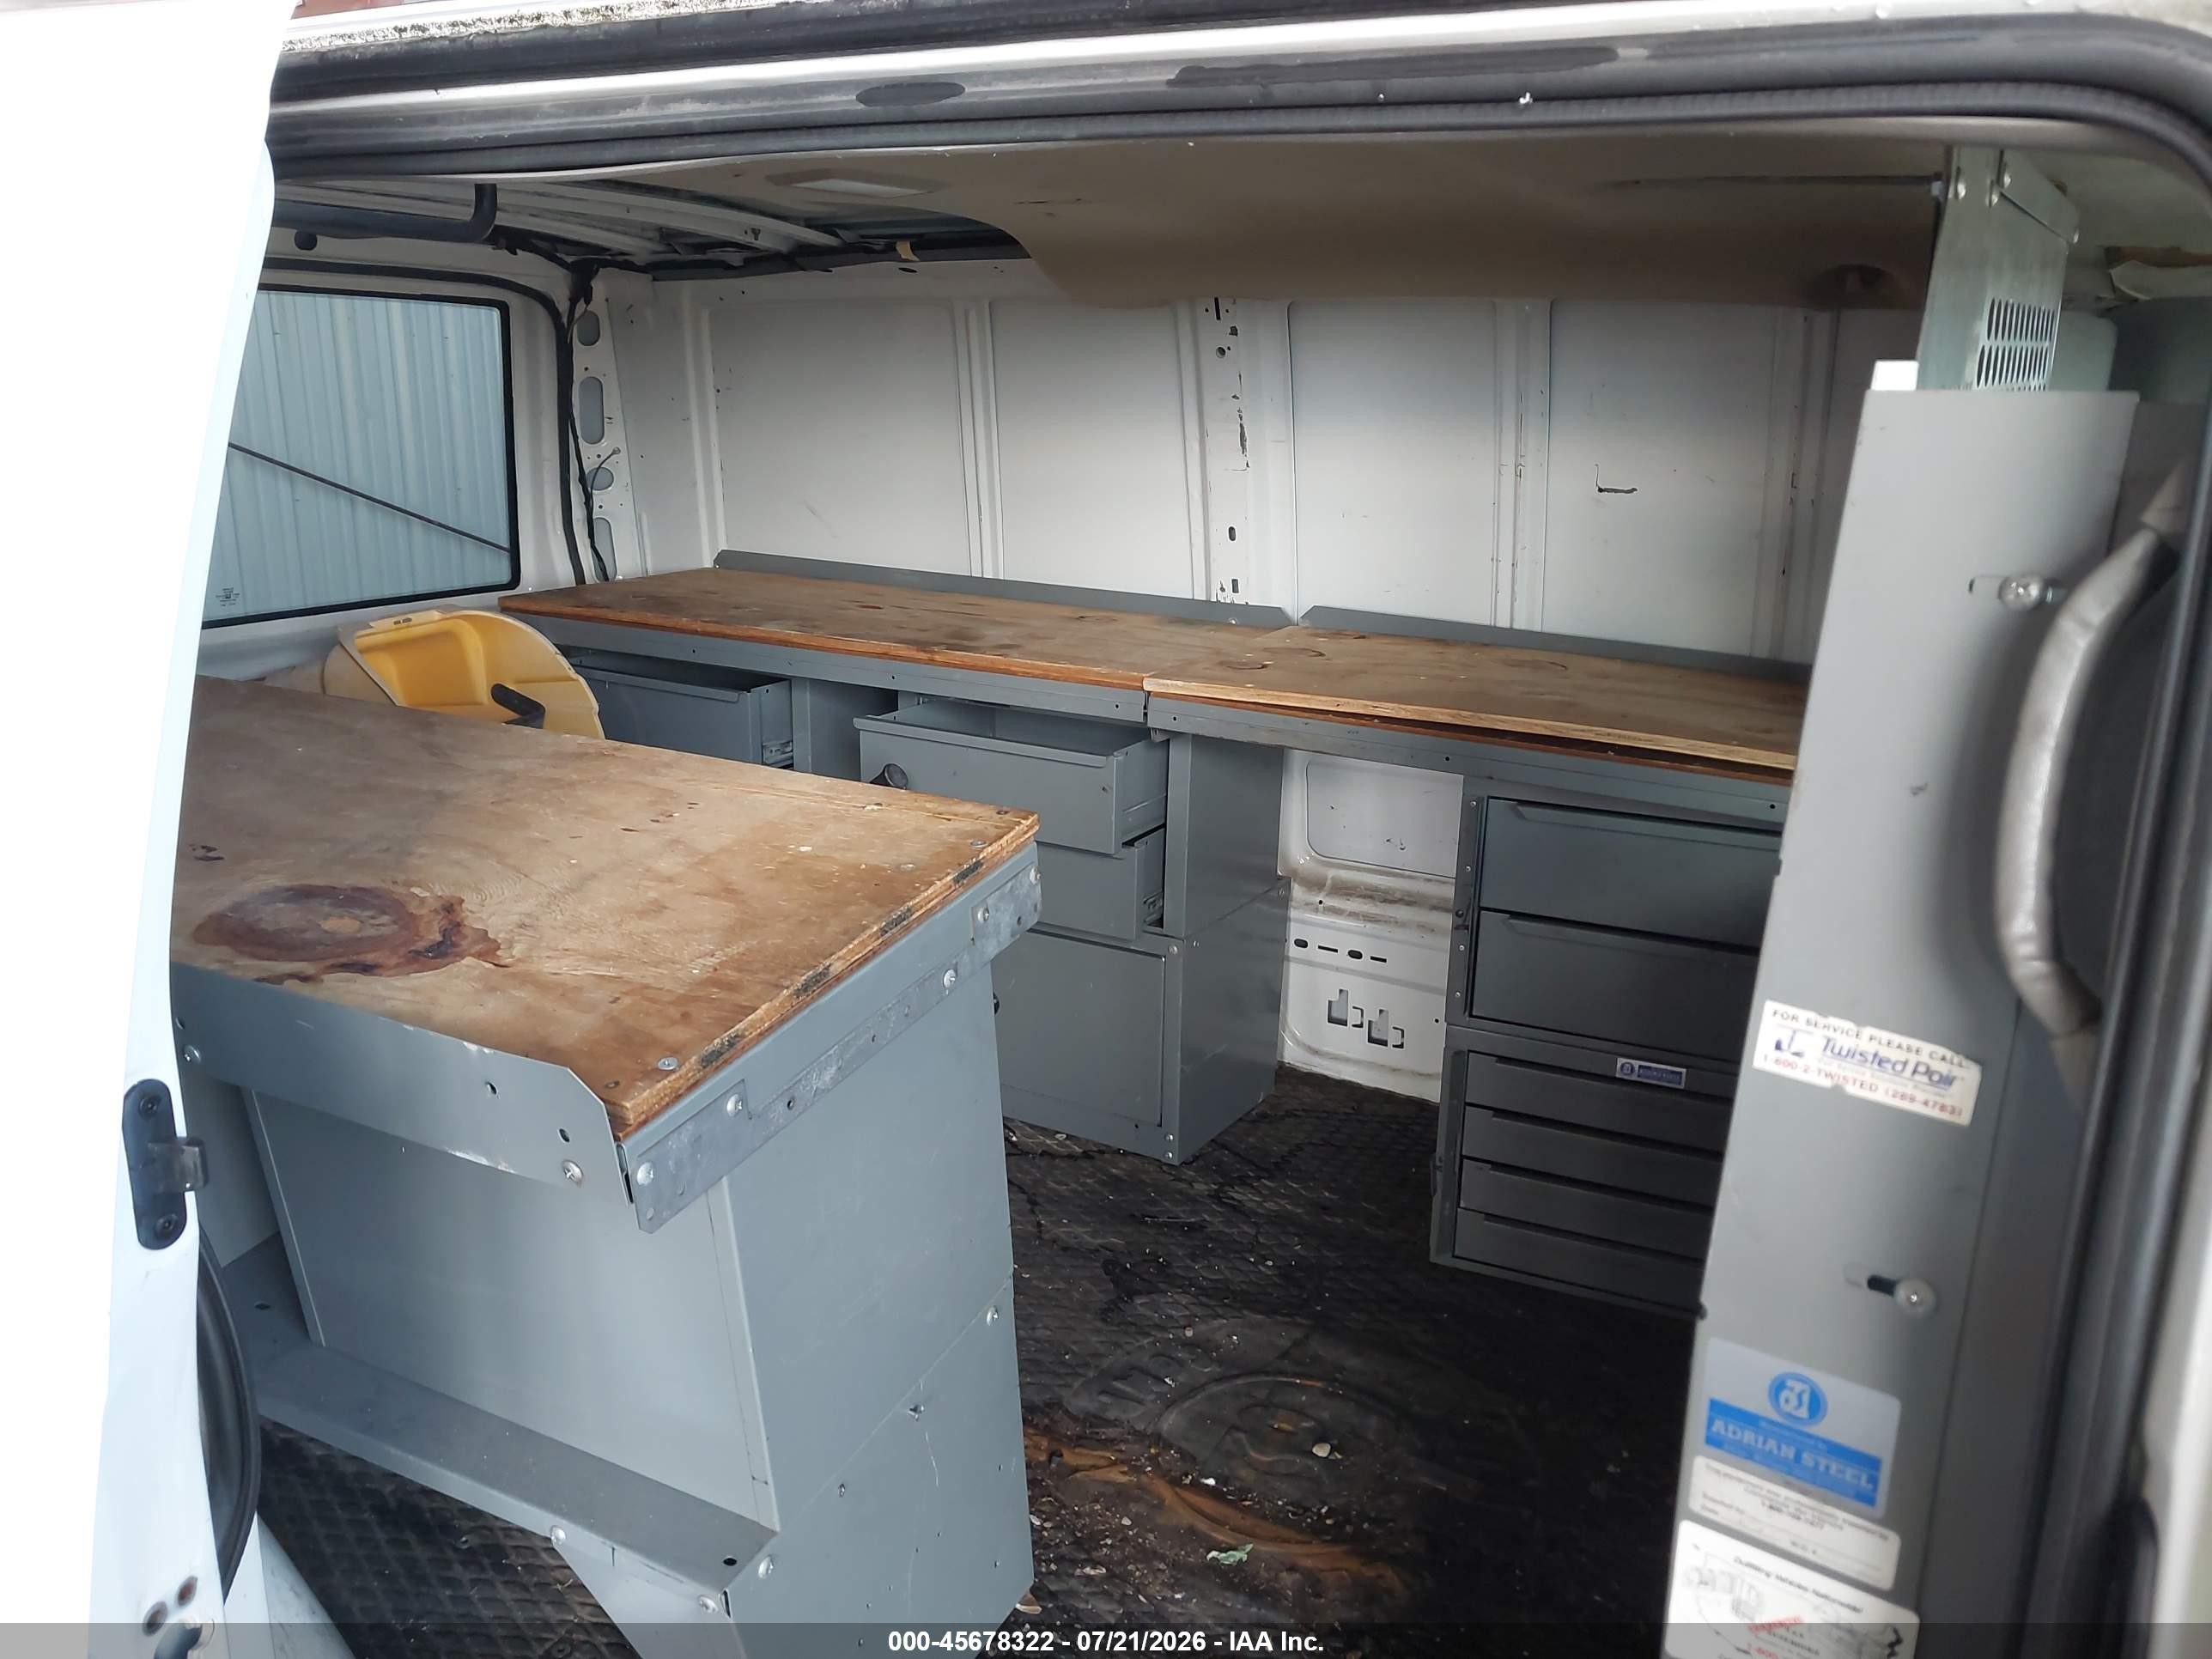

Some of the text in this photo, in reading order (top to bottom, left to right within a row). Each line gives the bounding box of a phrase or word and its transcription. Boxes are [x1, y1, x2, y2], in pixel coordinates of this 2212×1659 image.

[1771, 1008, 1799, 1024] FOR
[1806, 1015, 1862, 1040] SERVICE
[1869, 1033, 1923, 1056] PLEASE
[1822, 1036, 1908, 1073] Twisted
[1912, 1062, 1958, 1088] Pair
[1711, 1419, 1796, 1461] ADRIAN
[1801, 1451, 1873, 1489] STEEL
